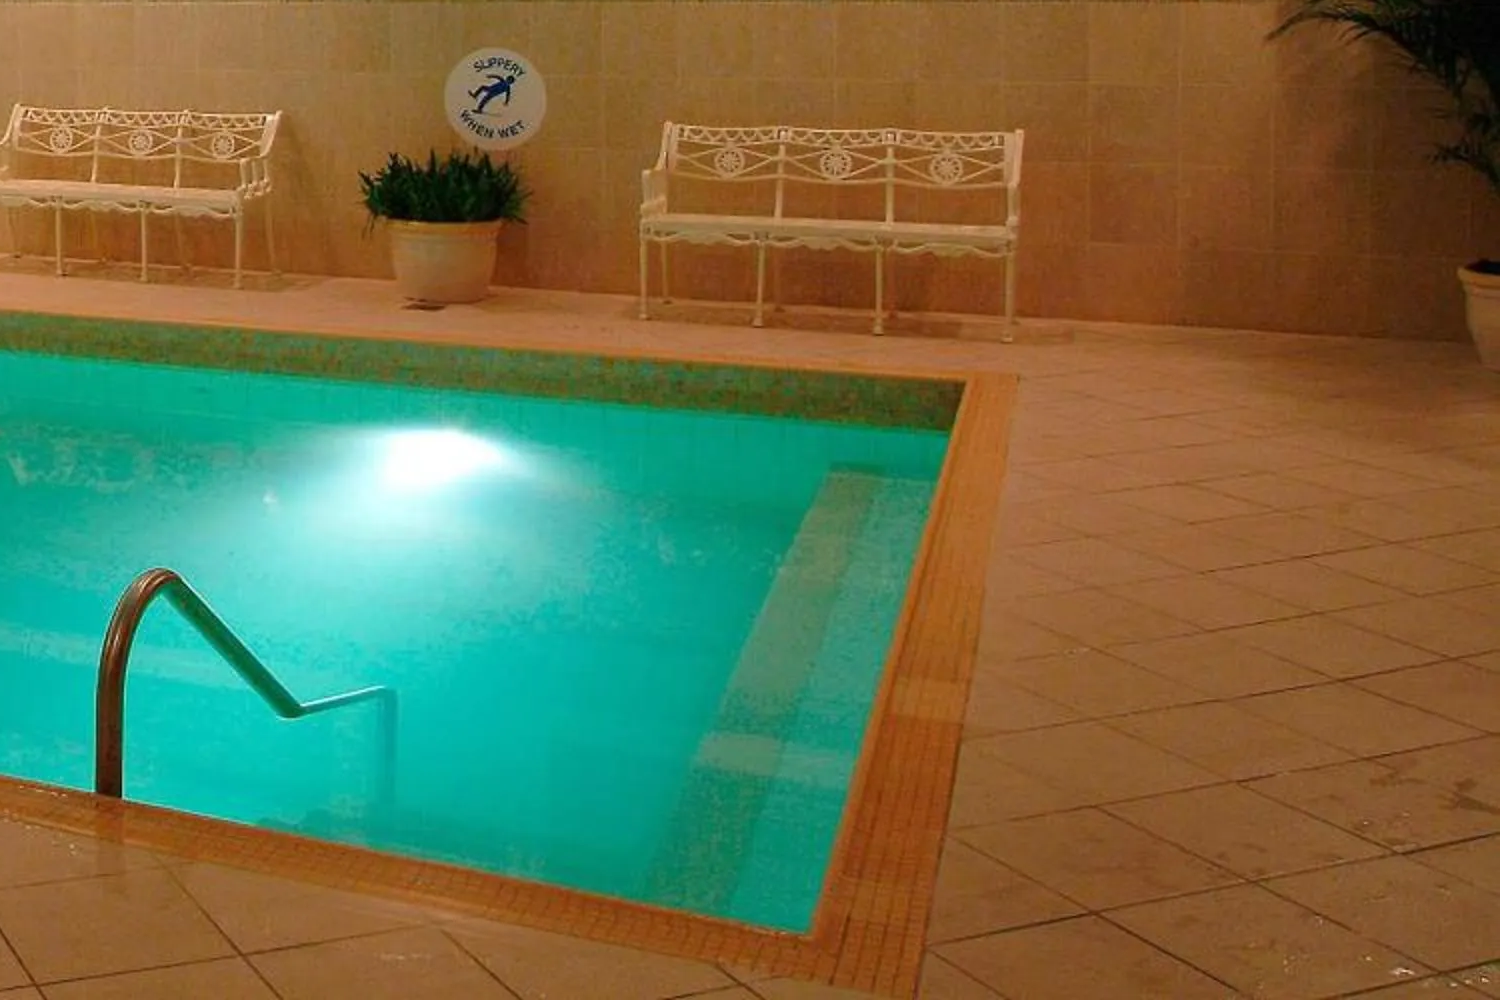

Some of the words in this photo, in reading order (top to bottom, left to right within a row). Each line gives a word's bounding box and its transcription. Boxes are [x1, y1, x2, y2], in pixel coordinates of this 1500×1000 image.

[473, 57, 526, 77] SLIPPERY
[460, 109, 495, 138] WHEN
[498, 120, 525, 138] WET
